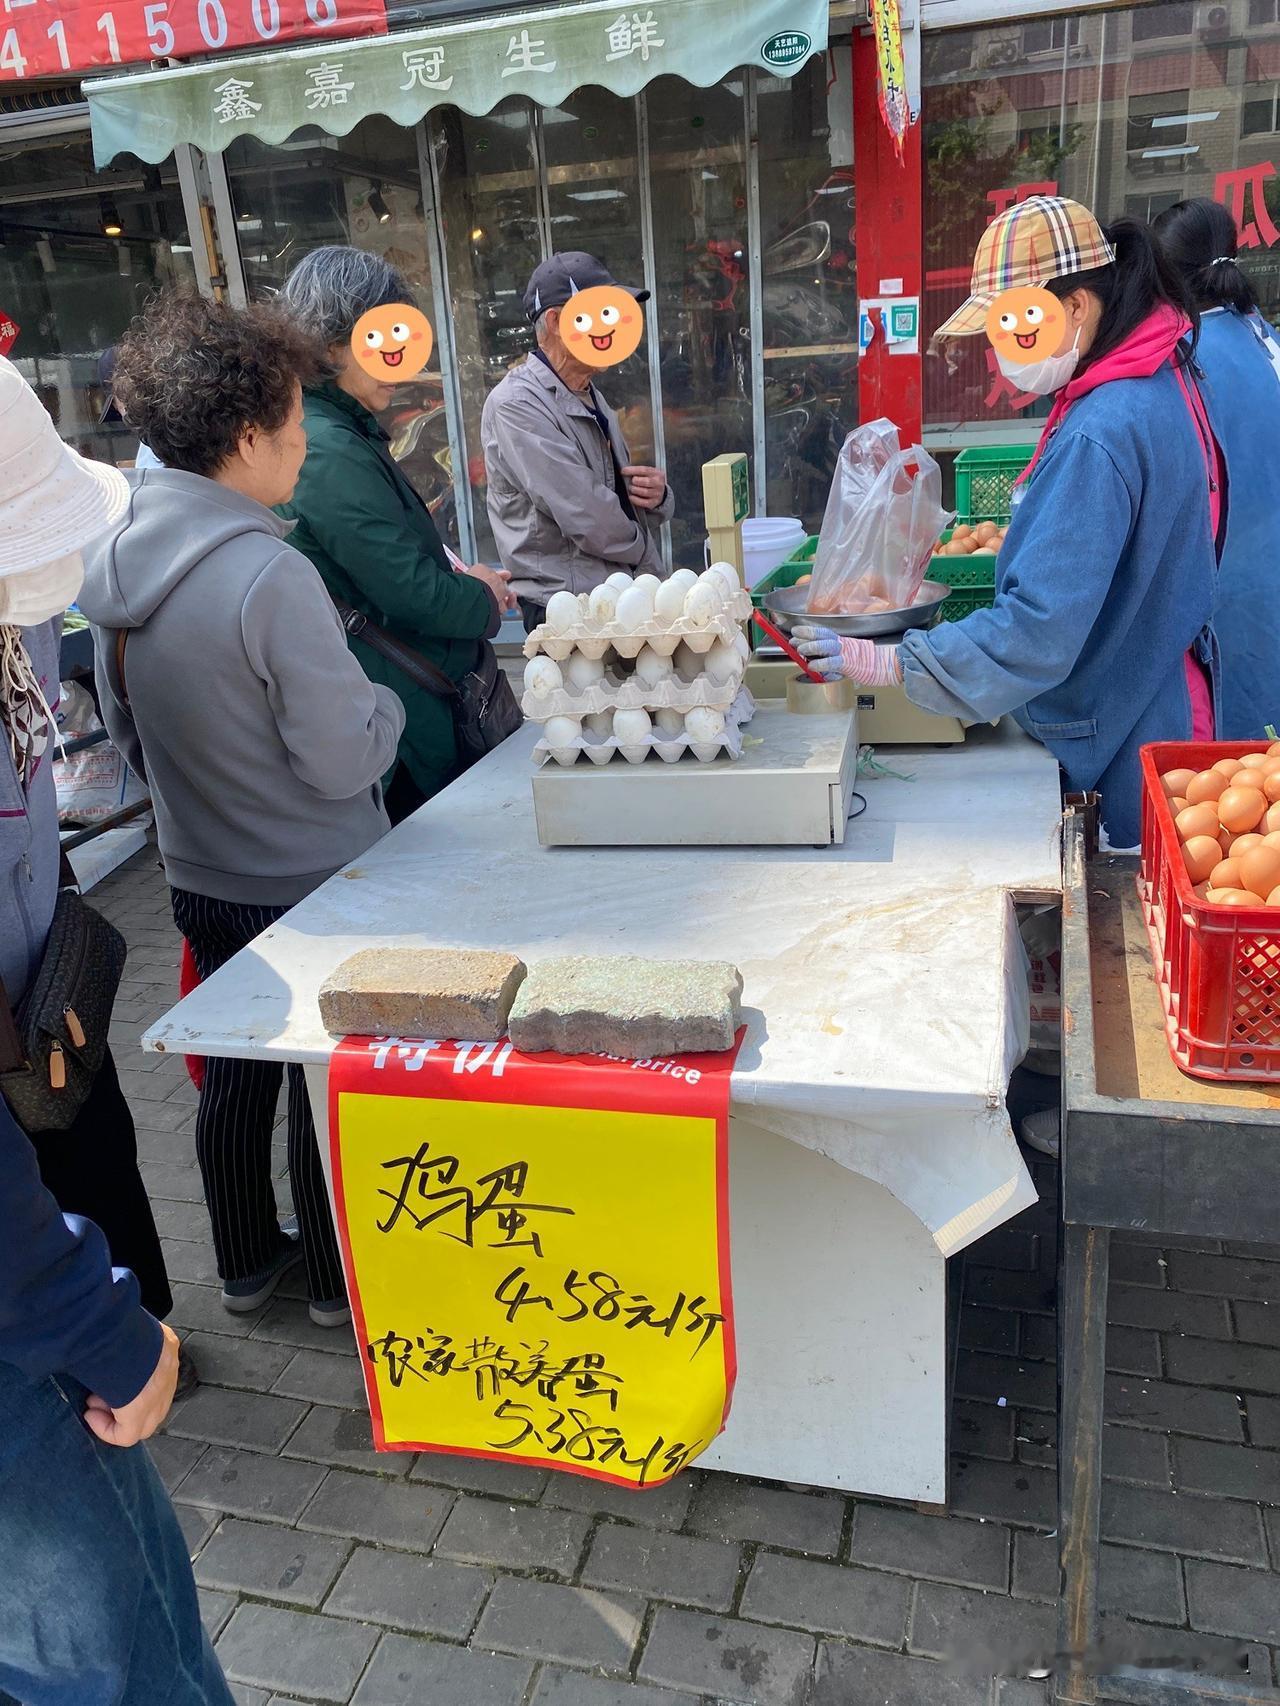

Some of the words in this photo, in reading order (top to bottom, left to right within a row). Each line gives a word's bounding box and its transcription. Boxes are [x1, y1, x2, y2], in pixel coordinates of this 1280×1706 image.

[213, 10, 665, 124] 鑫嘉冠生鲜
[632, 1055, 702, 1085] price
[376, 1142, 575, 1257] 鸡蛋
[366, 1327, 625, 1412] 农家散养蛋
